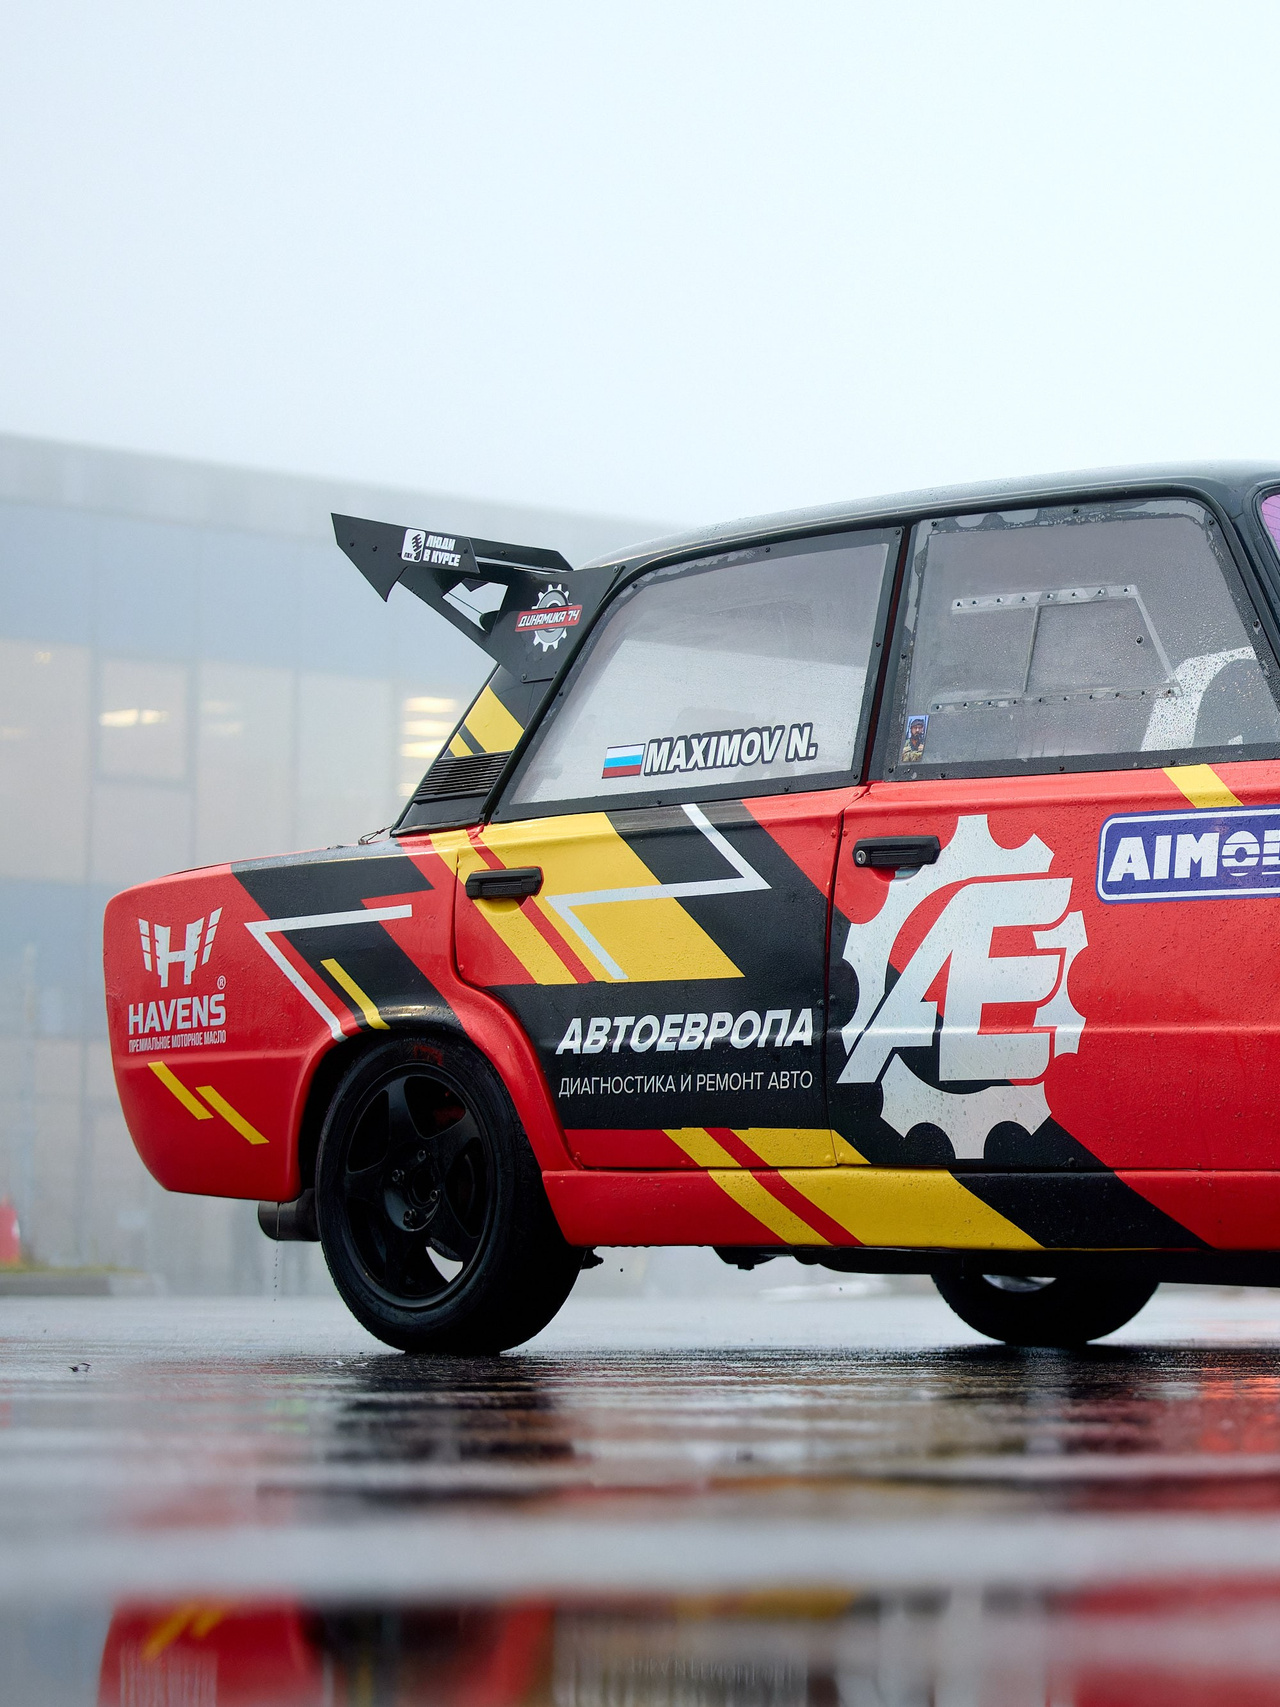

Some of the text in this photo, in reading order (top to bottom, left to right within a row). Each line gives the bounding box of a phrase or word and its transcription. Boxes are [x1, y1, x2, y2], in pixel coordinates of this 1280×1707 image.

[425, 534, 456, 551] ЛЮДИ
[422, 549, 462, 567] В КУРСЕ
[567, 609, 581, 622] 74
[645, 723, 817, 775] MAXIMOV N.
[128, 993, 227, 1036] HAVENS
[128, 1029, 227, 1054] ПРЕМИАЛЬНОЕ МОТОРНОЕ МАСЛО
[555, 1007, 813, 1056] АВТОЕВРОПА
[558, 1070, 813, 1099] ДИАГНОСТИКА И РЕМОНТ АВТО
